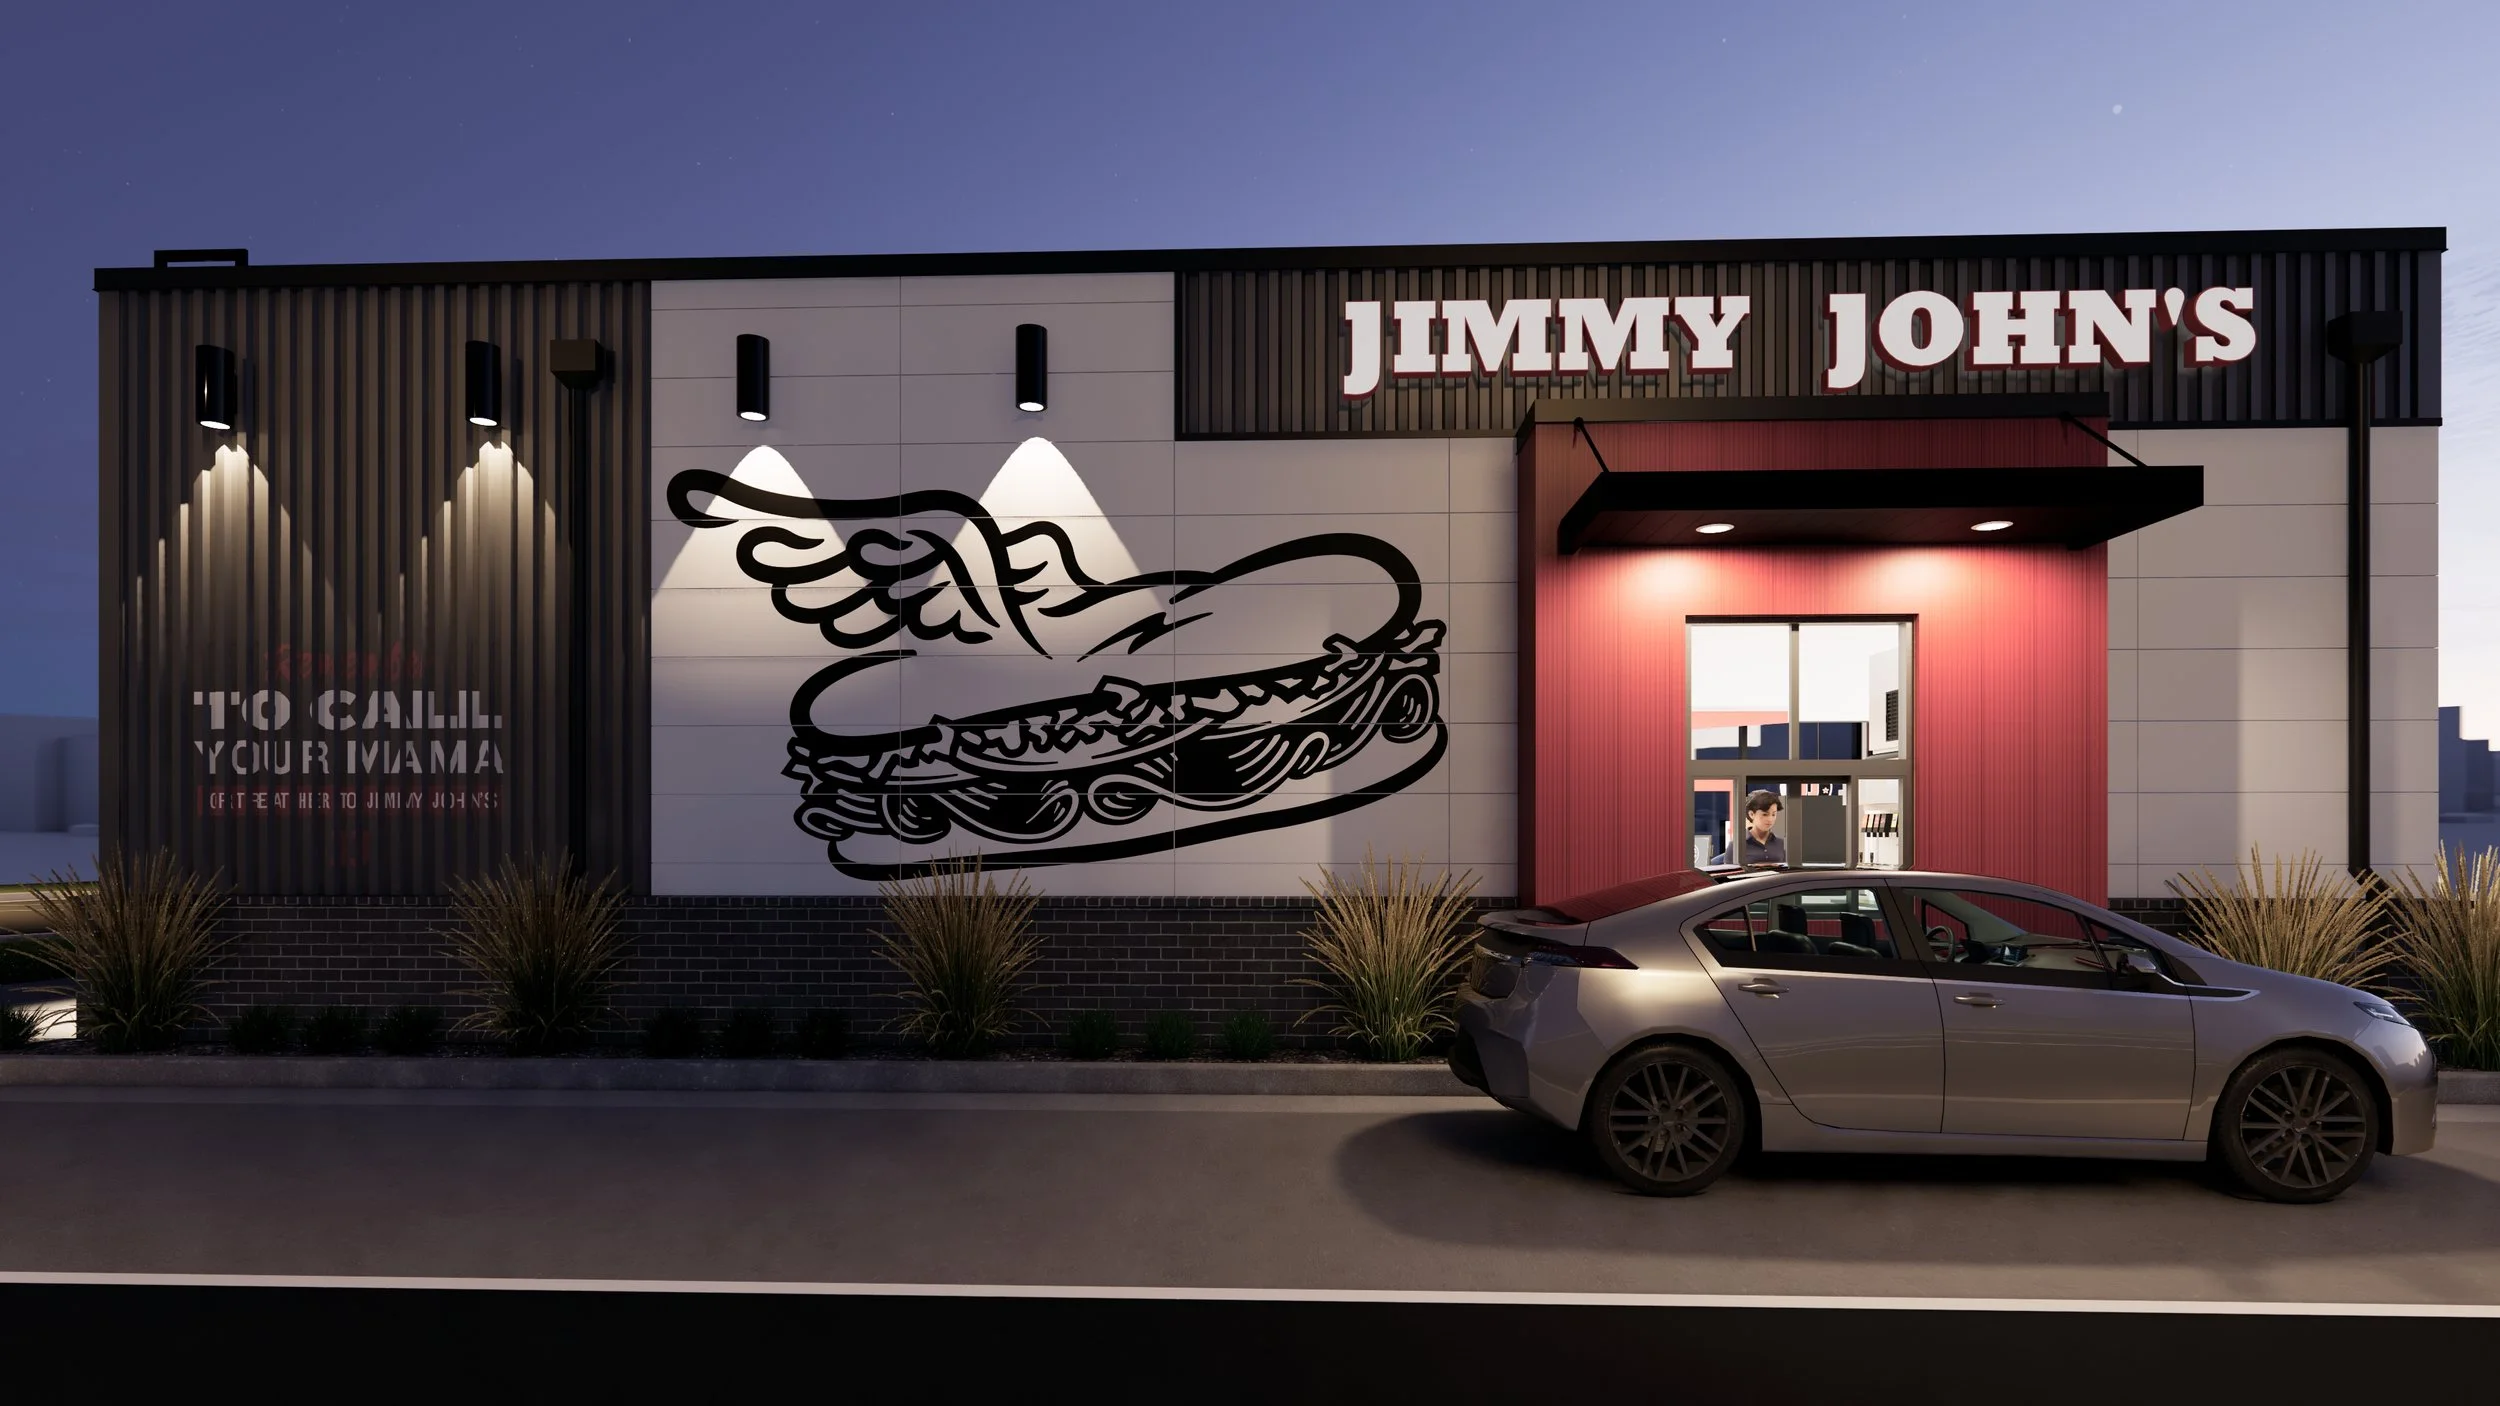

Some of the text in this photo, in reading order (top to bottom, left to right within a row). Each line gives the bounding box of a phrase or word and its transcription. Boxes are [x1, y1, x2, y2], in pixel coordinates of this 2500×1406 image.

[1342, 286, 2258, 397] JIMMY JOHN'S
[193, 689, 503, 731] TO CALL
[193, 739, 504, 776] YOUR MAMA
[298, 791, 331, 809] HER
[339, 791, 357, 809] TO
[366, 791, 423, 809] JIMMY
